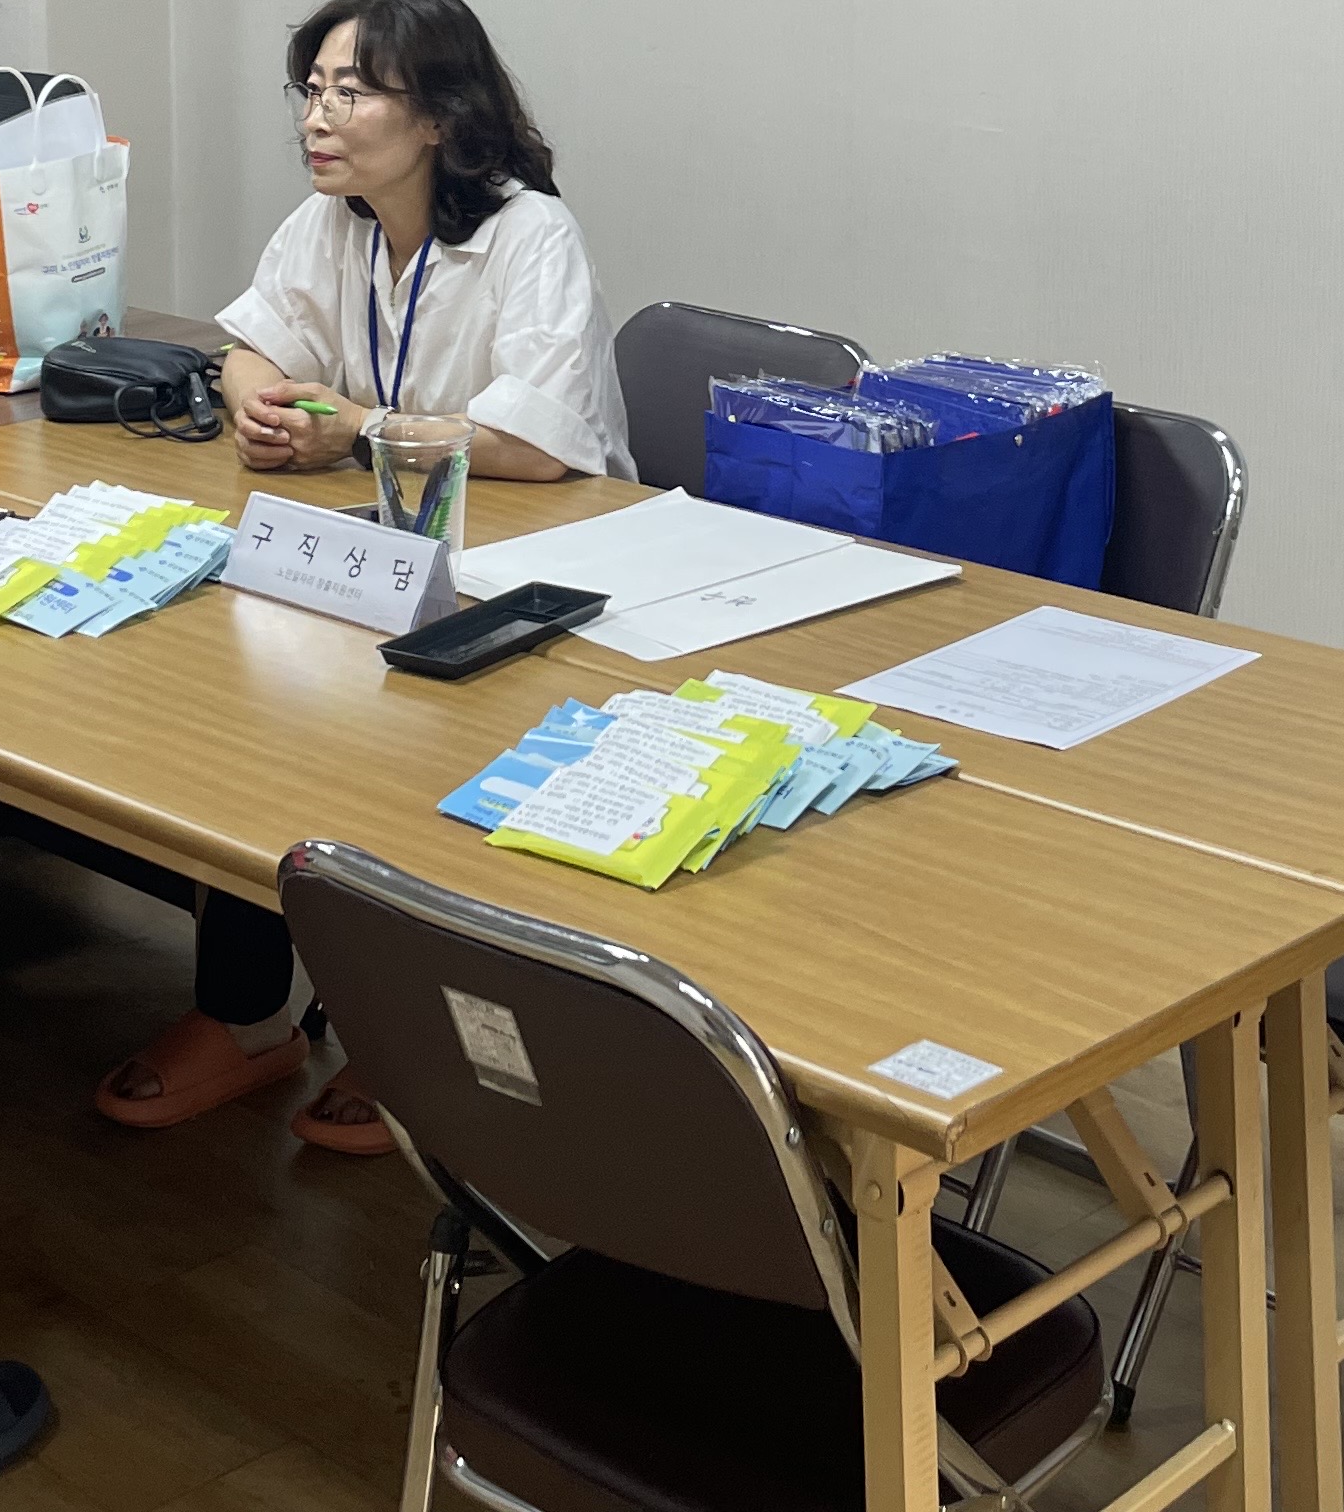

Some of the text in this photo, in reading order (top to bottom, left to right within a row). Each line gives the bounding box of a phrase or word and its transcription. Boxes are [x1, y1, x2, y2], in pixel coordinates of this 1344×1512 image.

[252, 521, 415, 592] 구 직 상 담
